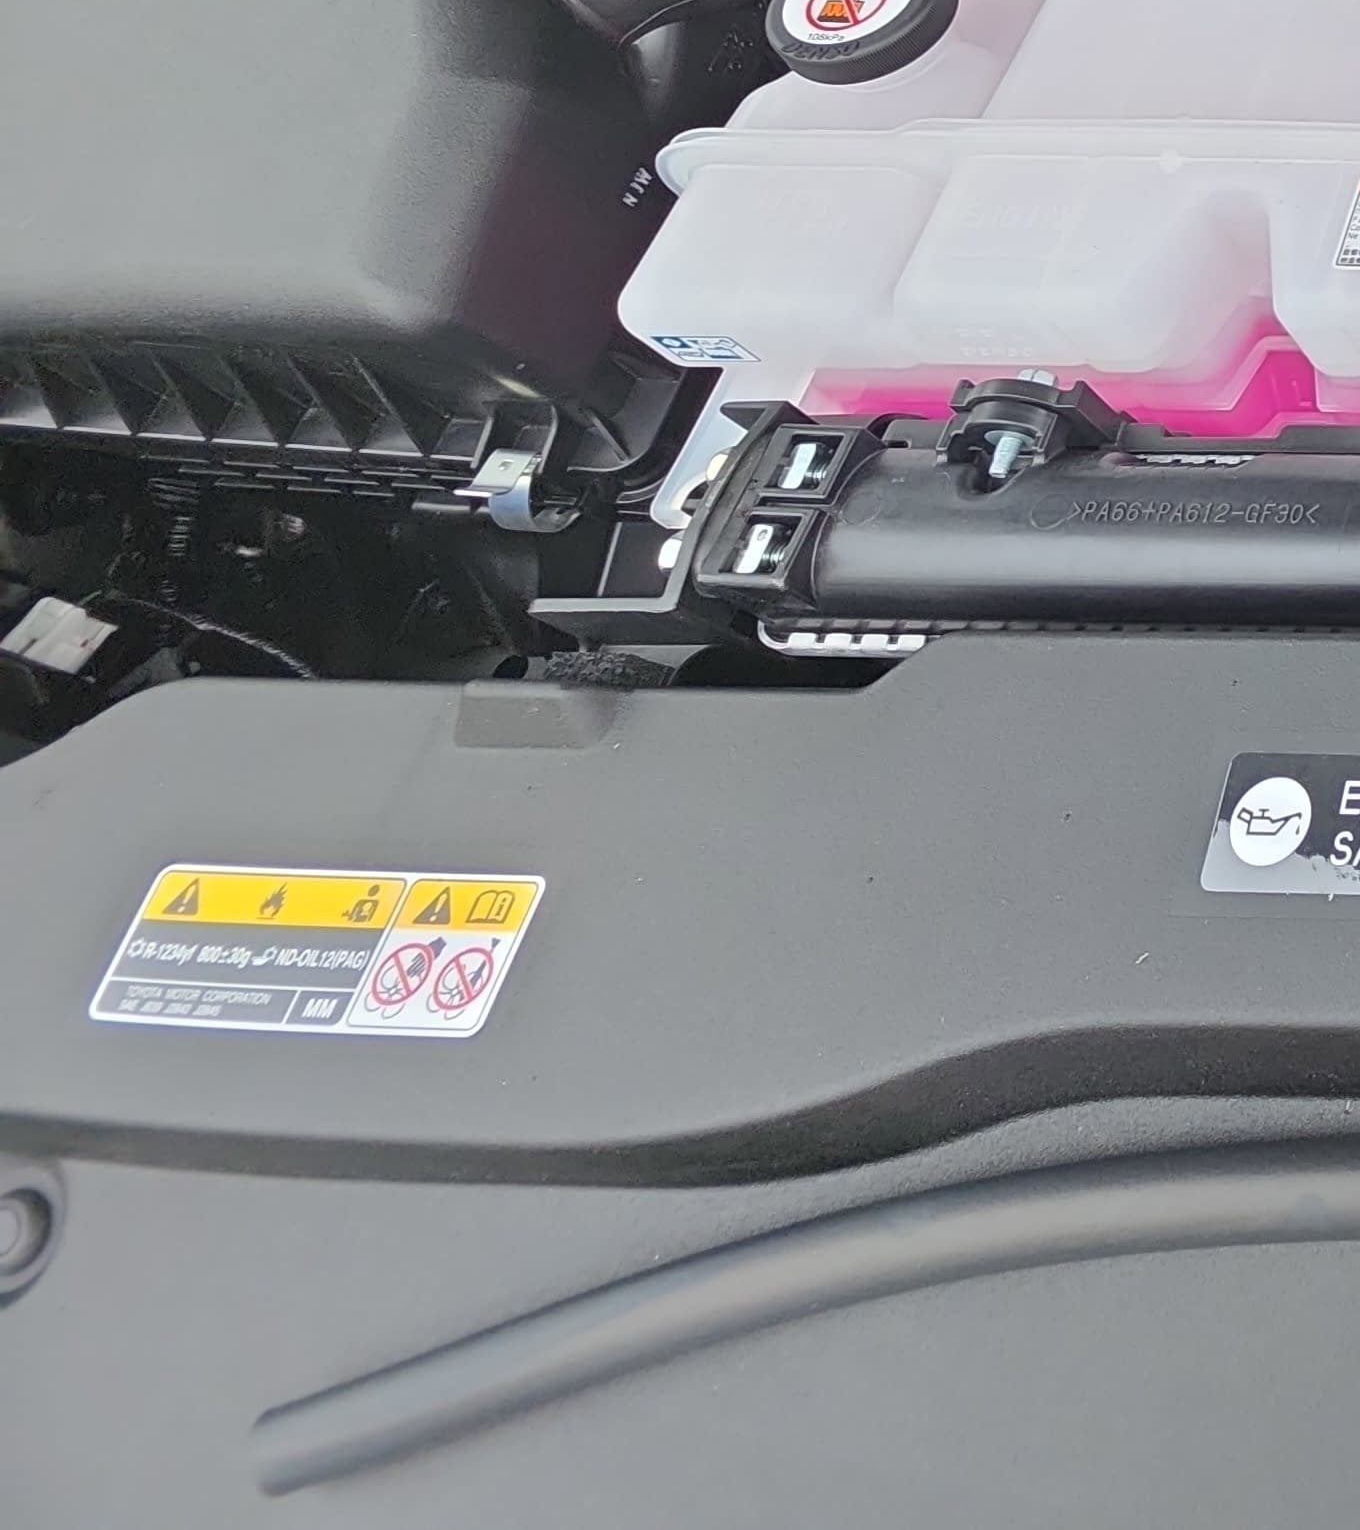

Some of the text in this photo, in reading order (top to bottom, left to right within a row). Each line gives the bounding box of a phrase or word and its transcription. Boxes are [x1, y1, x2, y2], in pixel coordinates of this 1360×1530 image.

[781, 41, 863, 60] DENSO
[126, 985, 272, 1005] TOYOTA MOTOR CORPORATION
[302, 998, 338, 1019] MM
